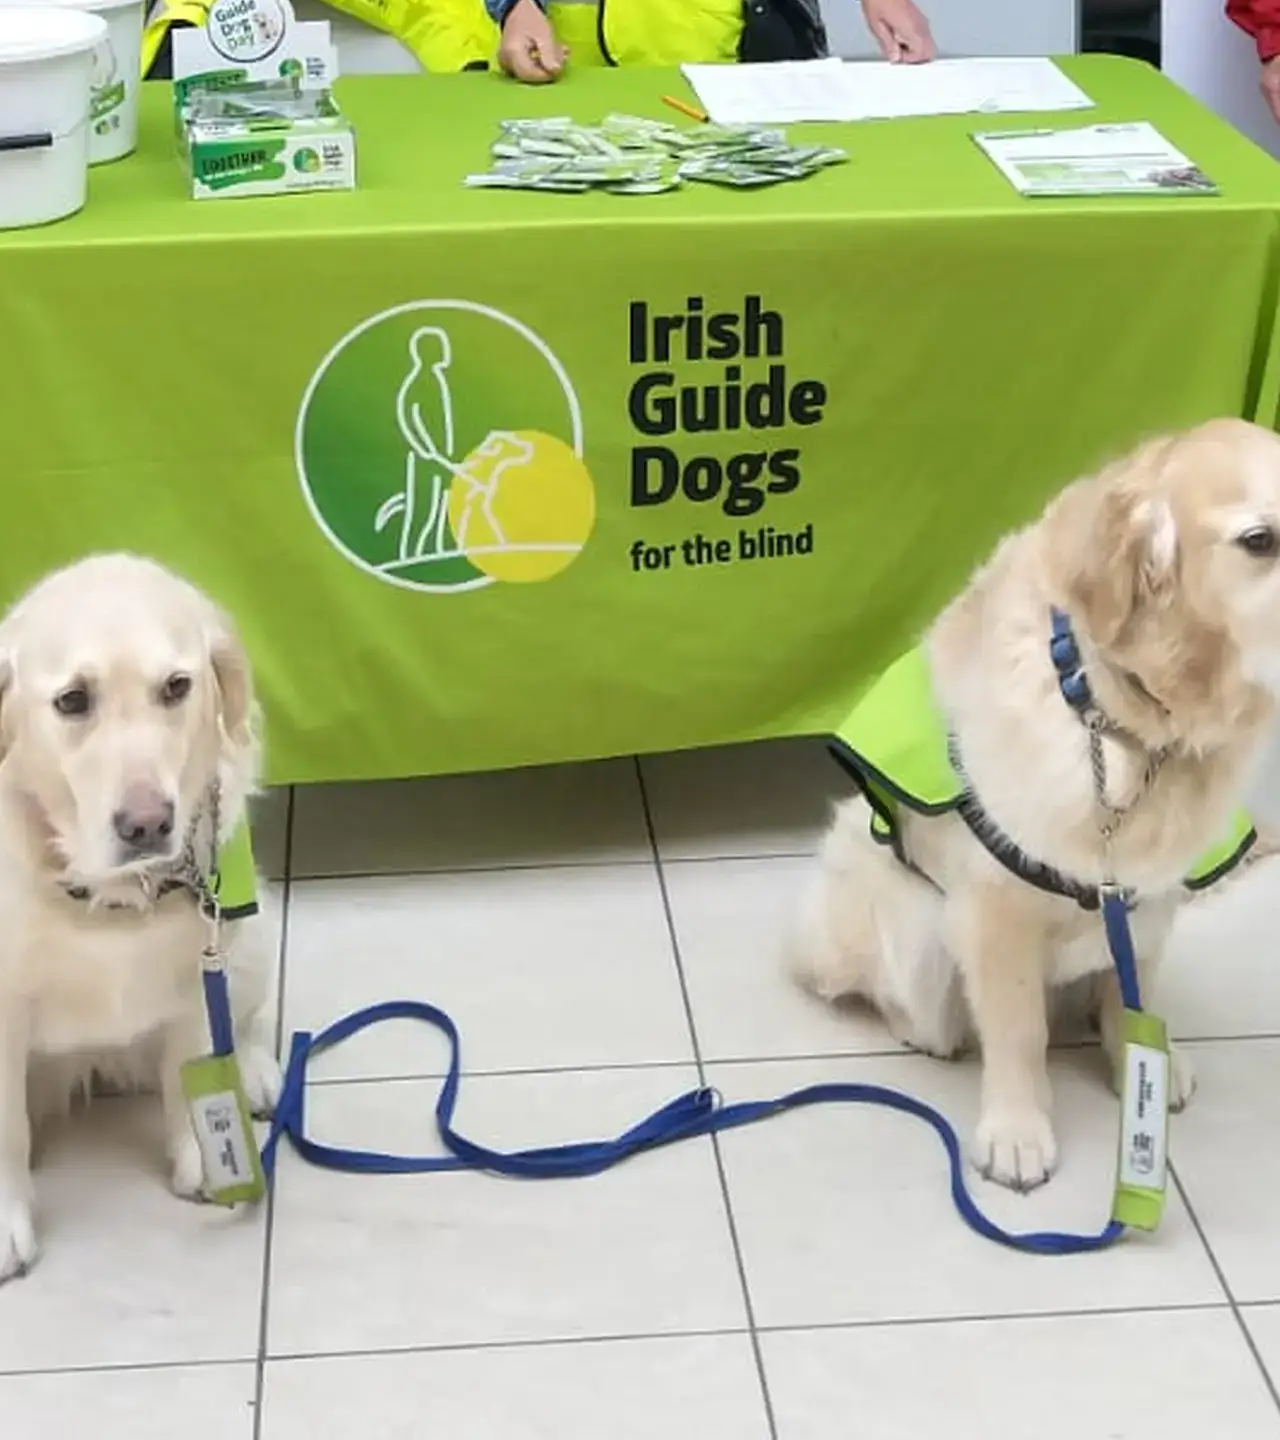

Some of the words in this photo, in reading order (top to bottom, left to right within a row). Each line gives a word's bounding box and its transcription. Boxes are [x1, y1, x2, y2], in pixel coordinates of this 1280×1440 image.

[628, 295, 784, 364] Irish
[628, 365, 828, 436] Guide
[630, 444, 801, 517] Dogs
[631, 539, 676, 572] for
[682, 533, 732, 566] the
[738, 524, 814, 561] blind
